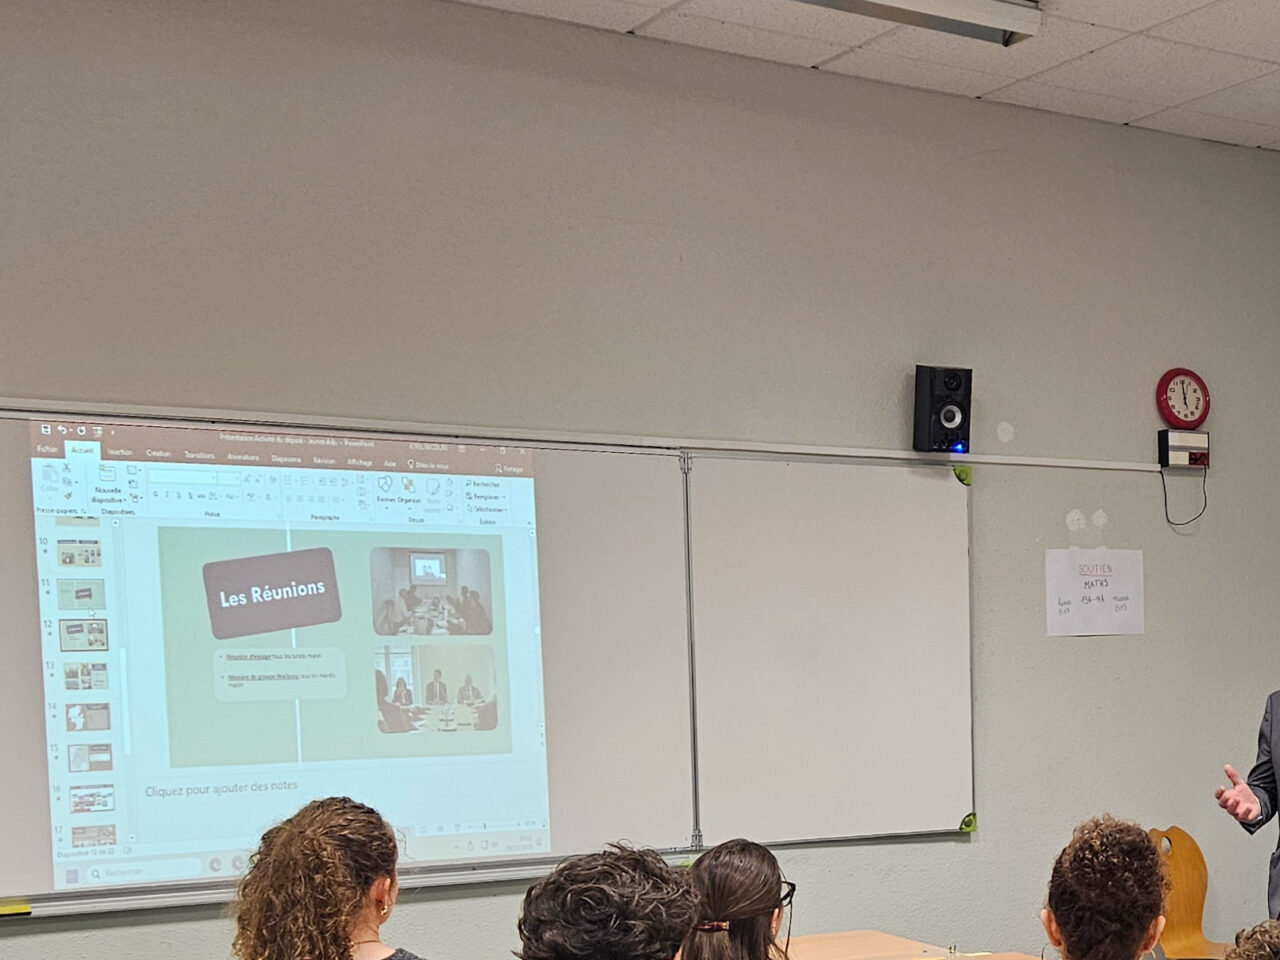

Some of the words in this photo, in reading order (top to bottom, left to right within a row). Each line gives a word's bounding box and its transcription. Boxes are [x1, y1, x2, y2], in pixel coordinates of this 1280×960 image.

[107, 448, 133, 456] Insertion
[184, 450, 216, 459] Transitions
[227, 453, 260, 461] Animations
[347, 458, 373, 467] Affichage
[1079, 564, 1112, 574] SOUTIEN
[42, 579, 50, 587] 11
[1084, 578, 1109, 589] MATHS
[220, 591, 247, 608] Les
[251, 581, 326, 603] Réunions
[44, 620, 52, 628] 12
[46, 661, 54, 669] 13
[145, 786, 184, 799] Cliquez
[186, 787, 210, 798] pour
[213, 783, 249, 796] ajouter
[251, 781, 269, 792] des
[270, 781, 298, 792] notes
